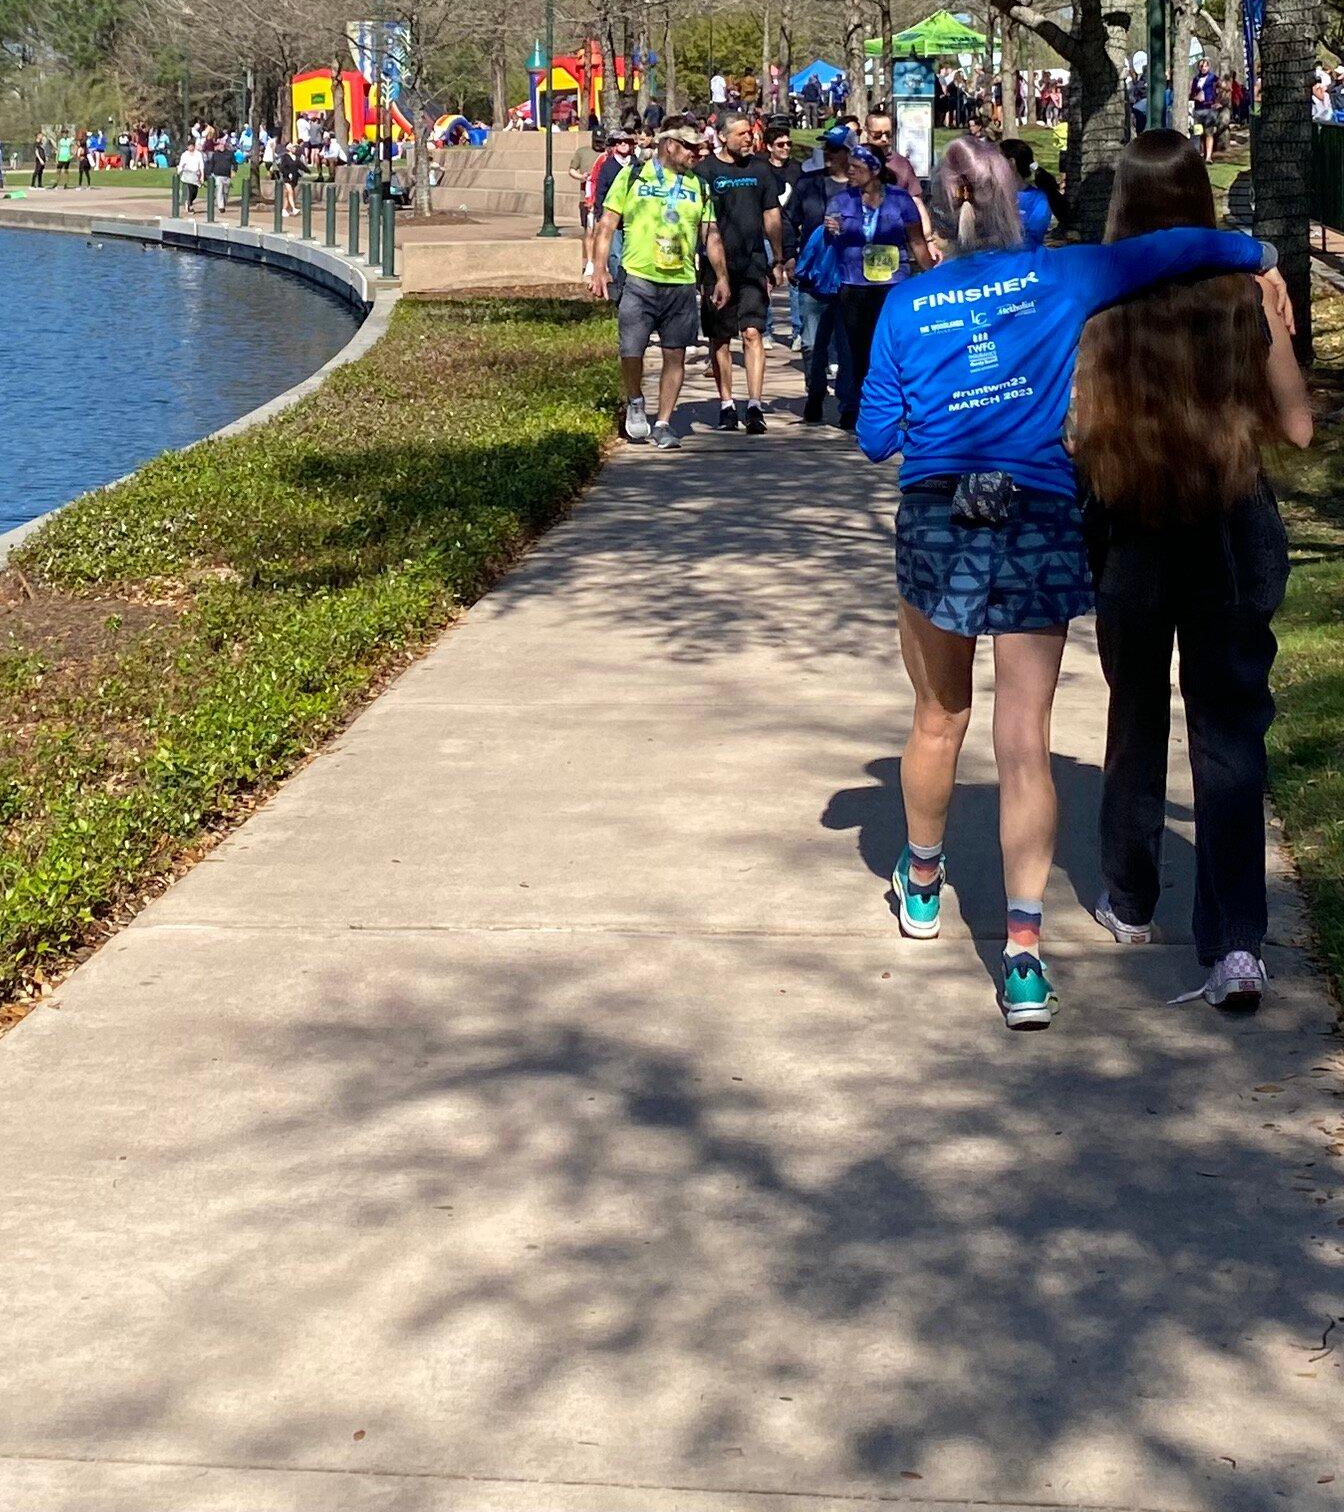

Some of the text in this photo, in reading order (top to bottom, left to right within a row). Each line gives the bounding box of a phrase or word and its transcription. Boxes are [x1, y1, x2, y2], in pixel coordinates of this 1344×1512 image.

[912, 271, 1039, 312] FINISHER
[948, 387, 1034, 412] MARCH 2023
[952, 376, 1027, 399] #runtwm23
